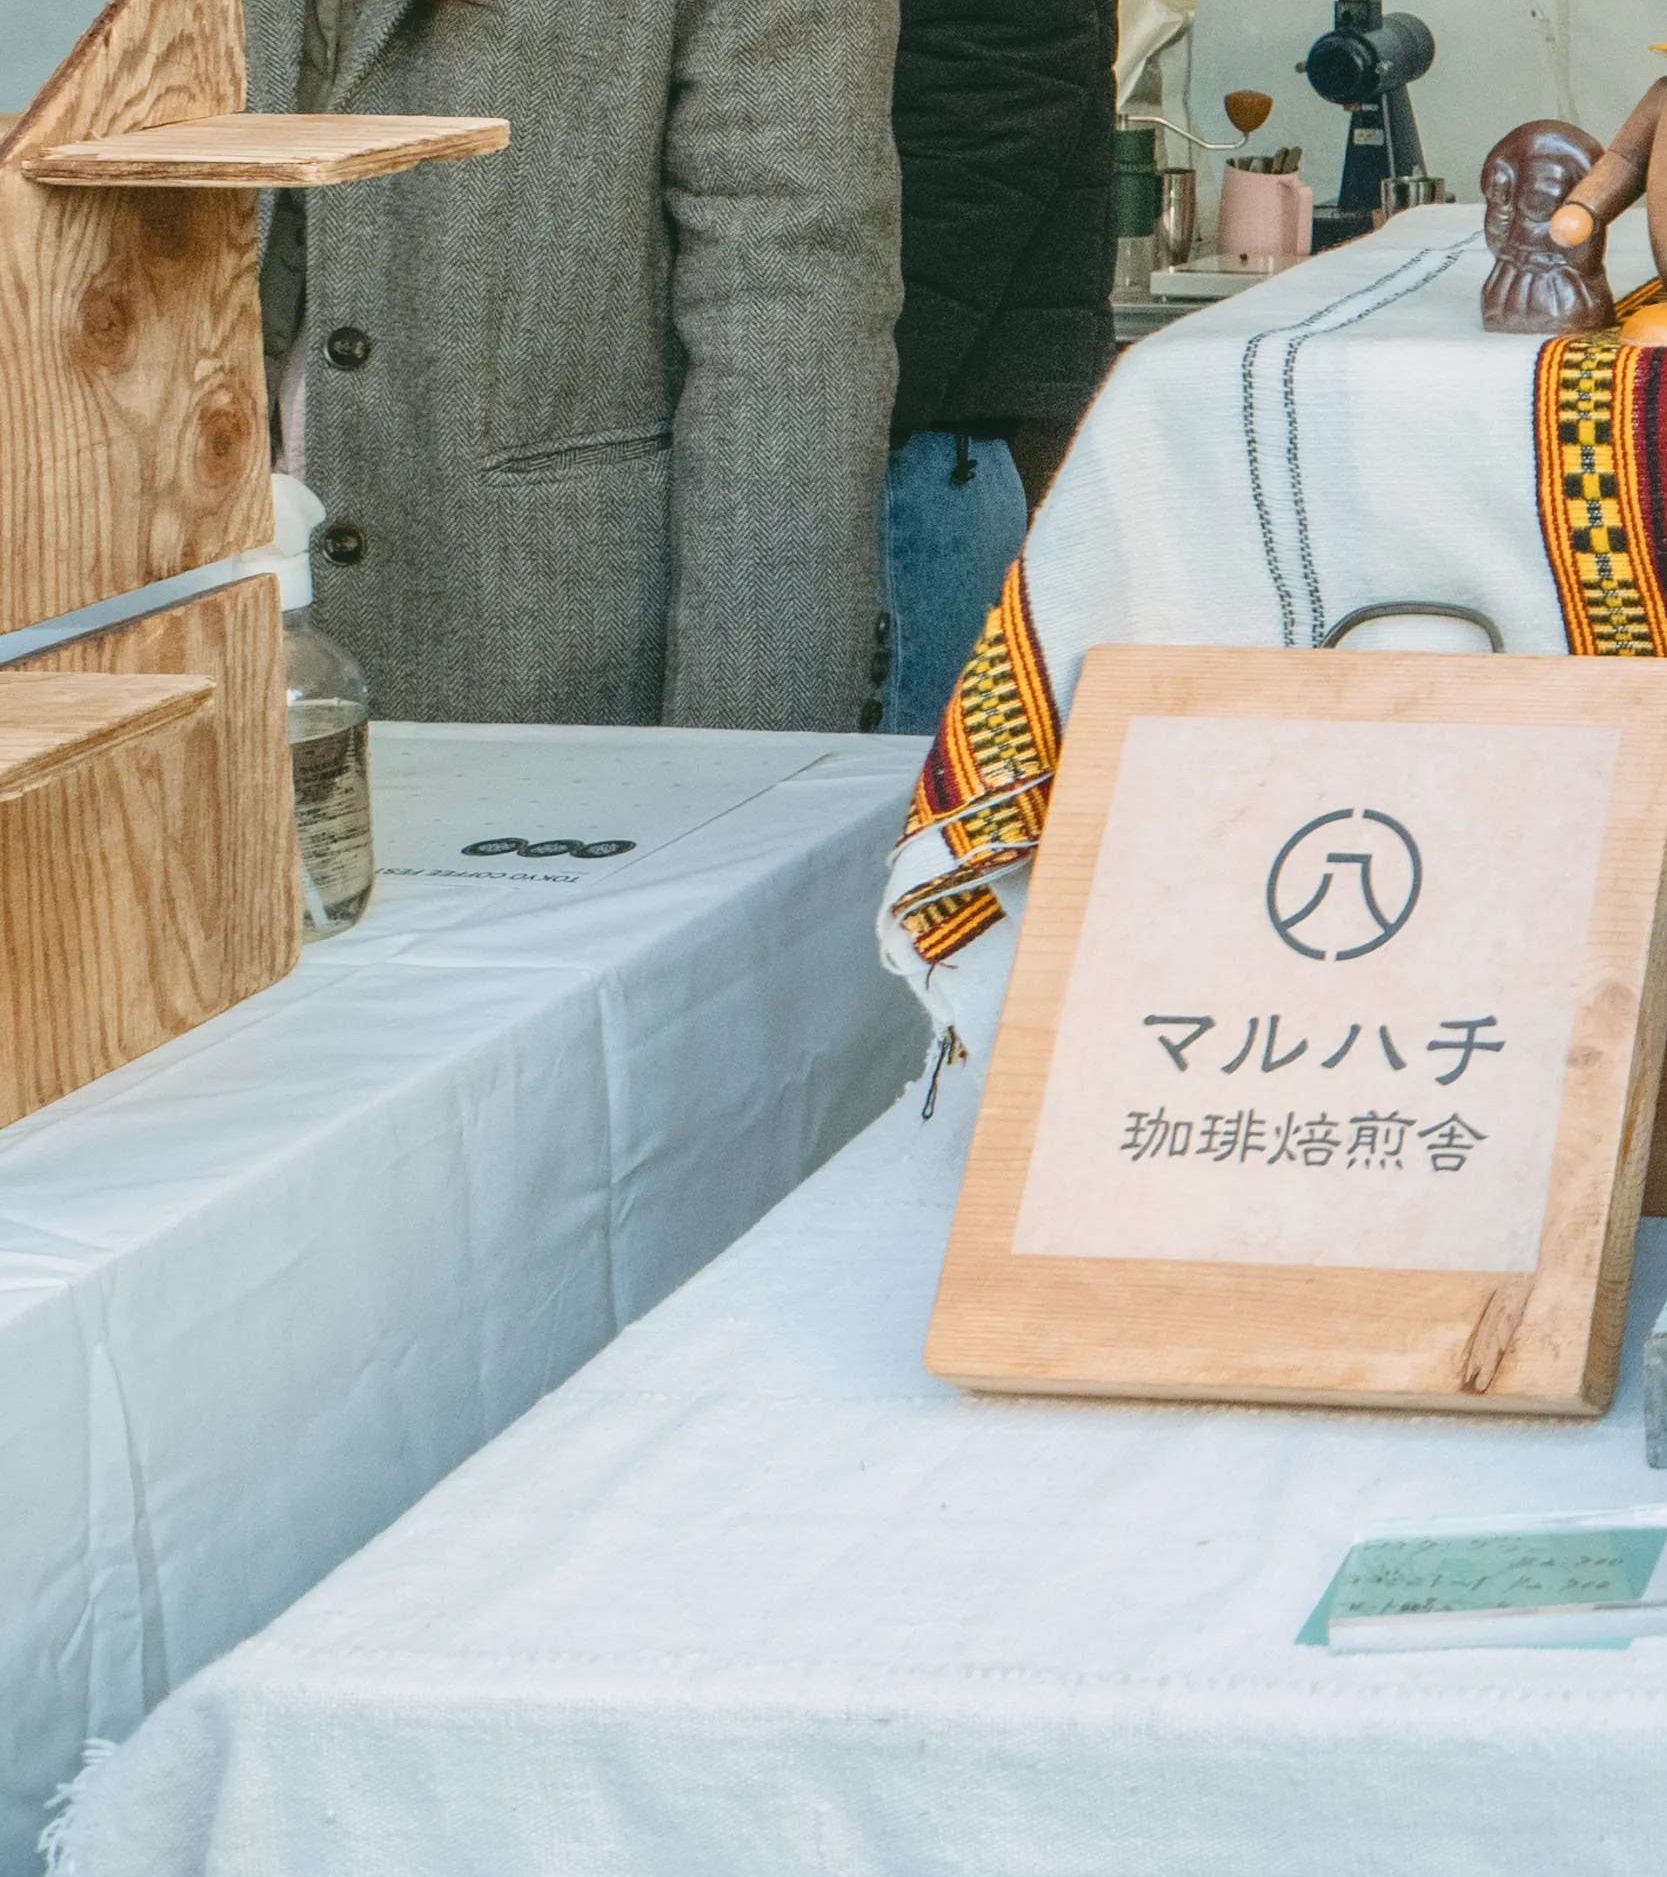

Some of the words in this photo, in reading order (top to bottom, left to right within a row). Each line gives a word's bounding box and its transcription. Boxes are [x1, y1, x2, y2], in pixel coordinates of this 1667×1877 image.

[1141, 1013, 1507, 1086] マルハチ
[1120, 1107, 1488, 1173] 珈琲焙煎舎
